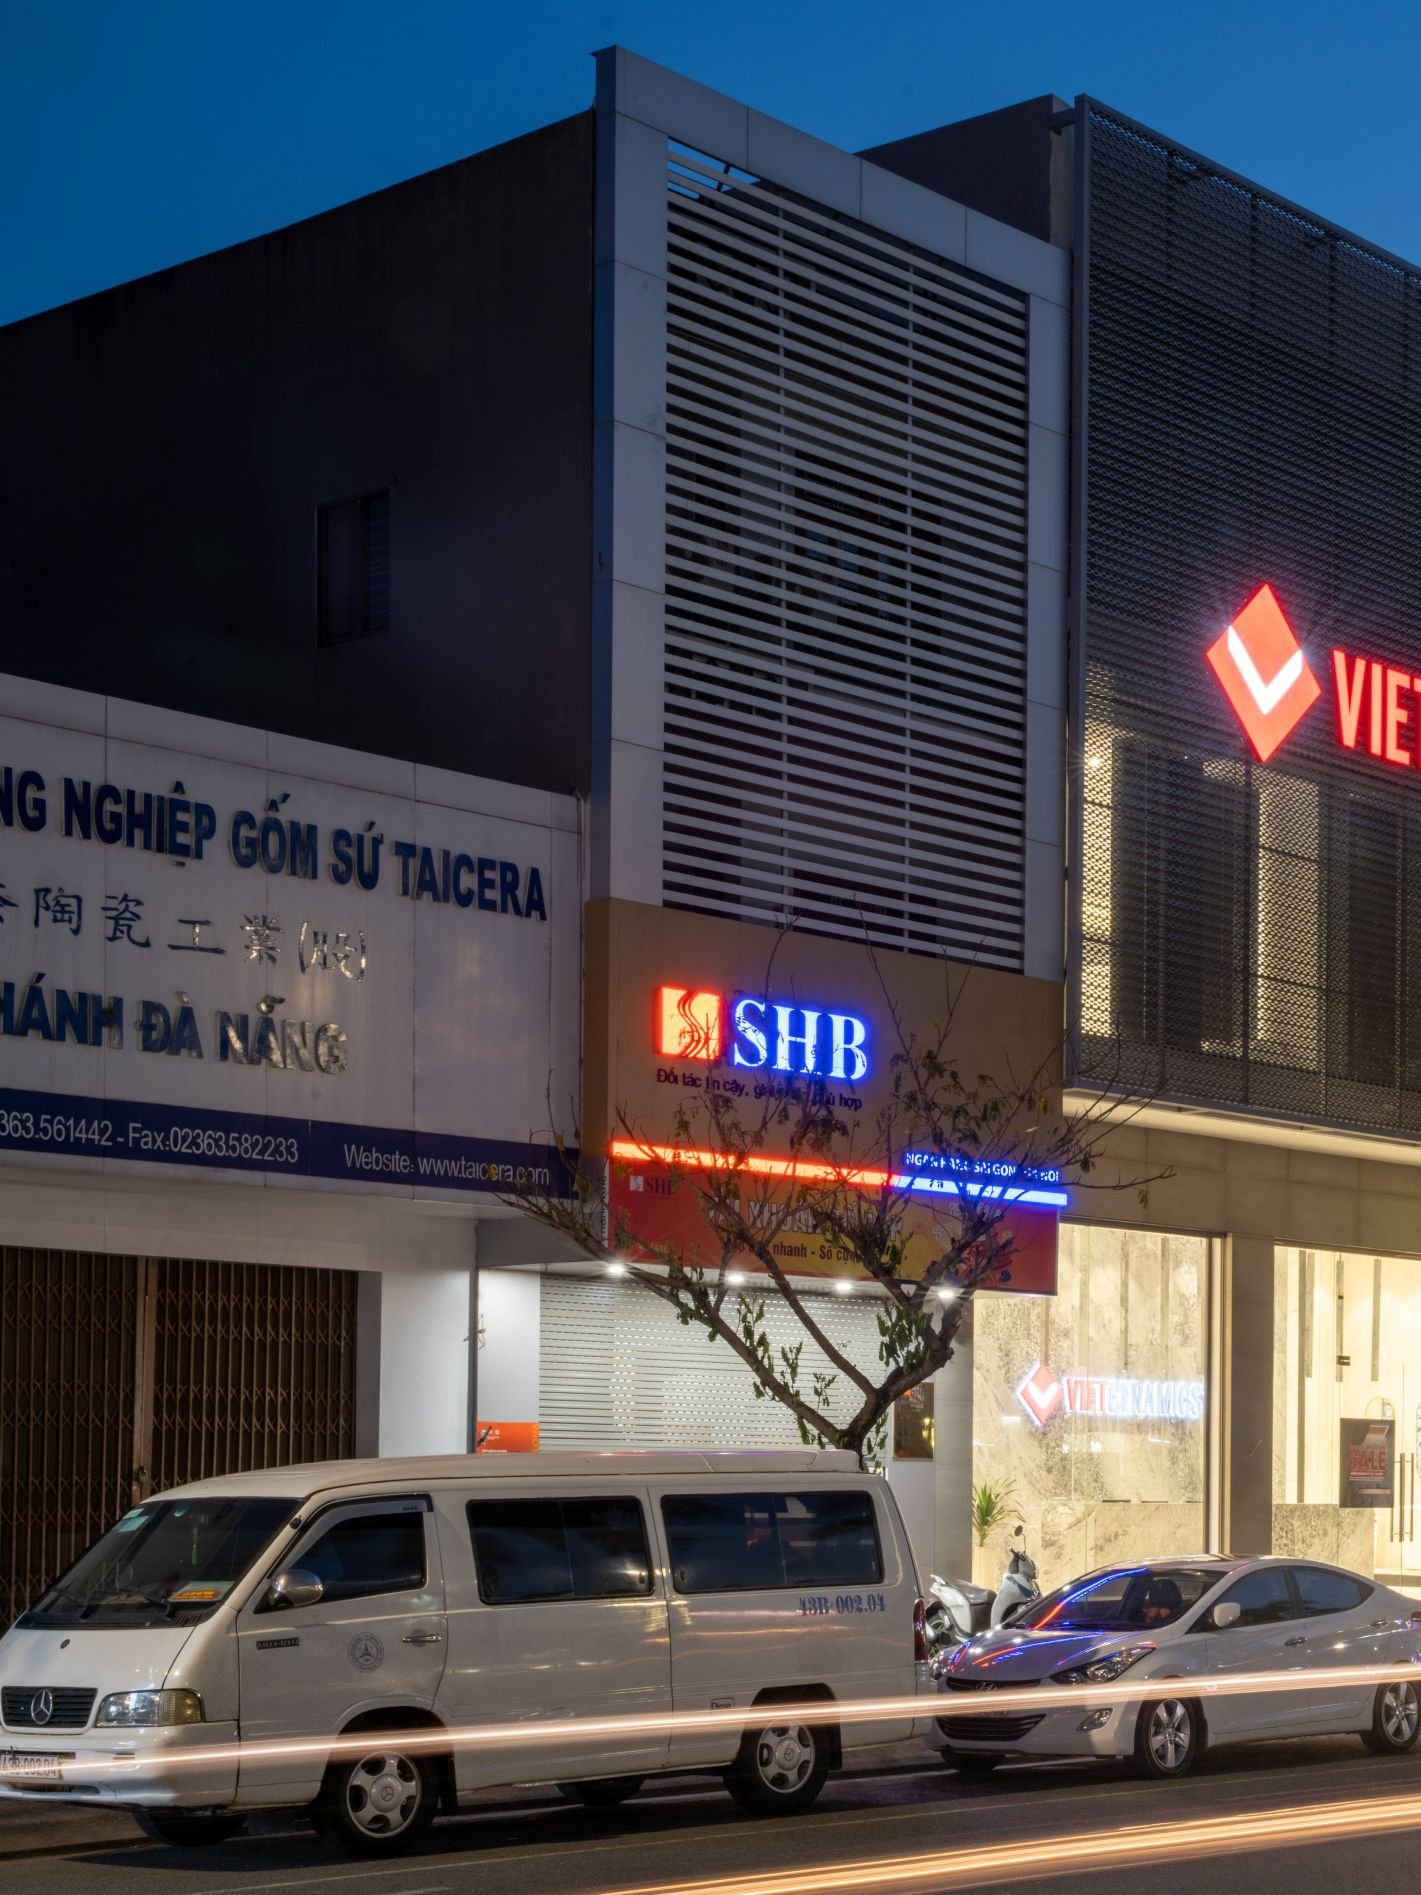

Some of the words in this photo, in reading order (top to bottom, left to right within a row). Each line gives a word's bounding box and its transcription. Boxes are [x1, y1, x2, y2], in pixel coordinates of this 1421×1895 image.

[62, 777, 216, 867] NGHIỆP
[229, 792, 319, 881] GỐM
[330, 820, 384, 891] SỨ
[392, 839, 548, 922] TAICERA
[135, 990, 203, 1059] ĐÀ
[733, 998, 868, 1081] SHB
[682, 1072, 702, 1088] tác
[344, 1143, 415, 1173] Website:
[773, 1242, 807, 1259] nhanh
